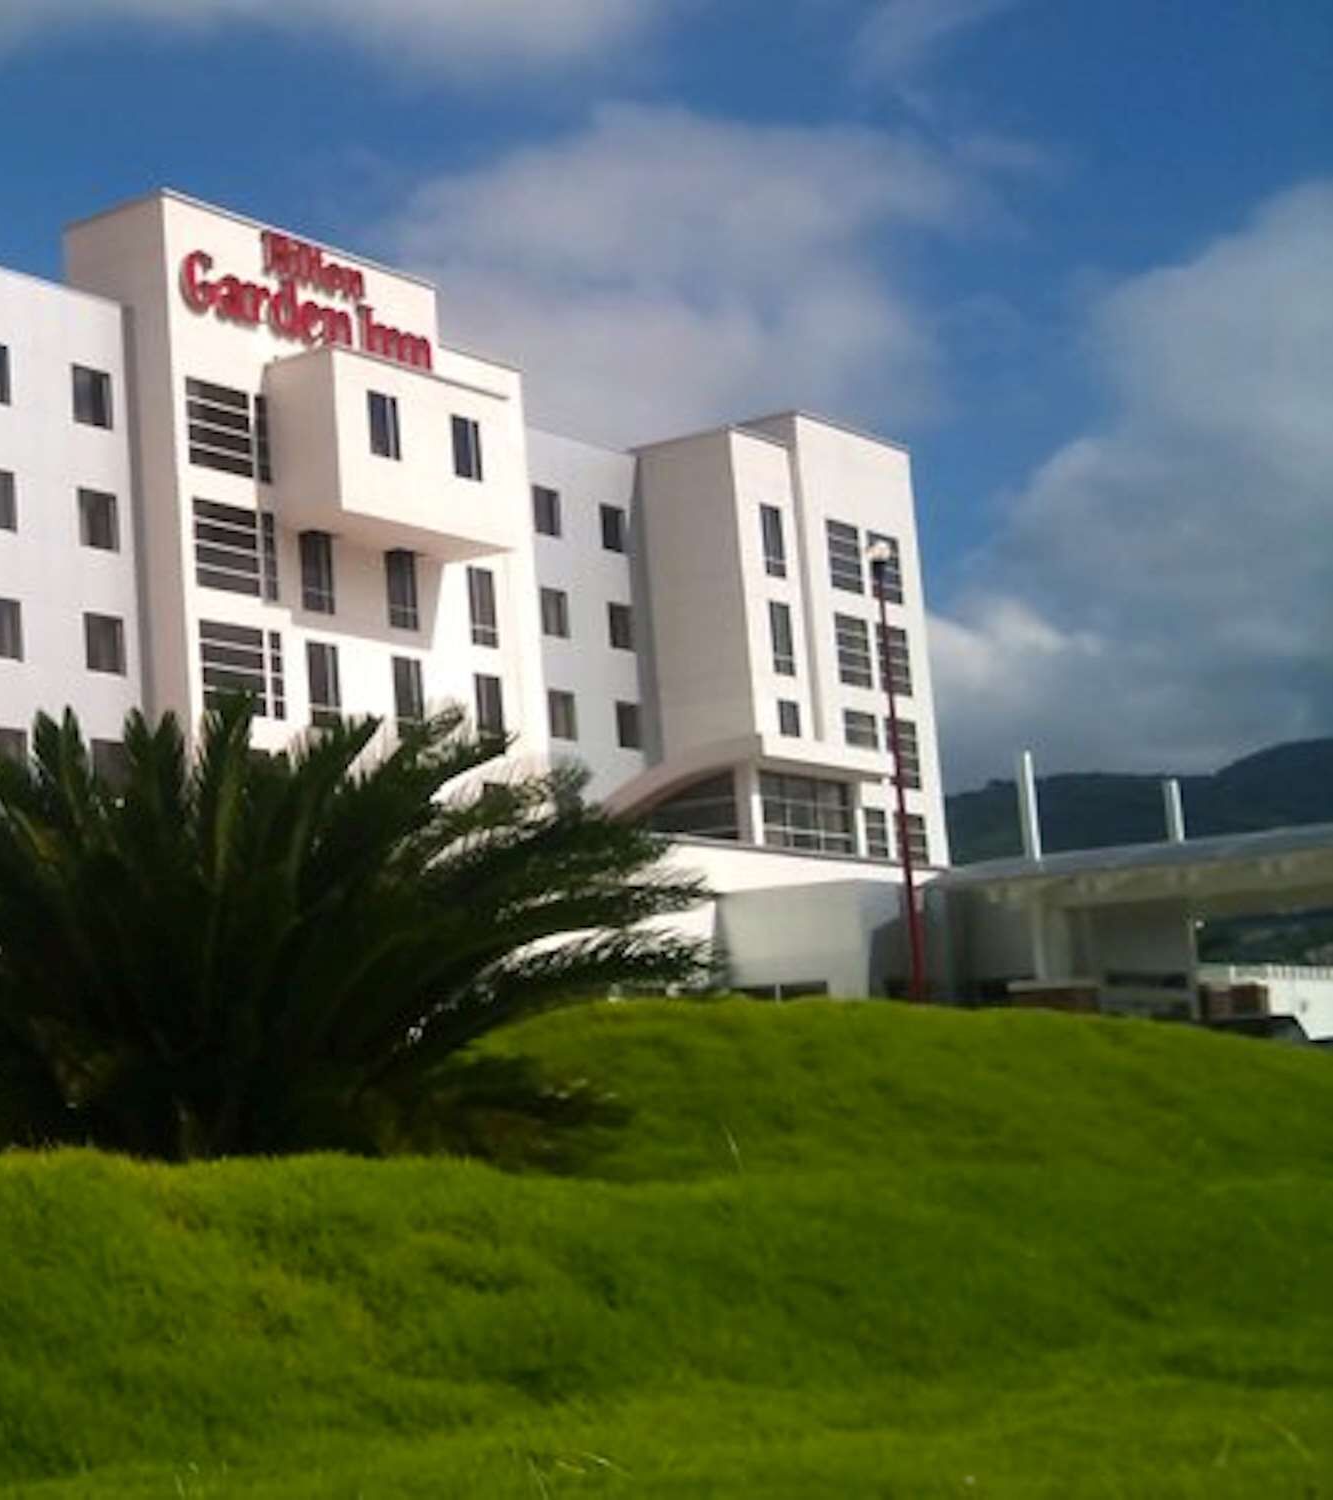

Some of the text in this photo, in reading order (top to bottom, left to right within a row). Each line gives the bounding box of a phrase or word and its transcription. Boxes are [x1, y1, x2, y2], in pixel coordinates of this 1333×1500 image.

[179, 250, 432, 370] Garden Inn
[261, 231, 364, 298] Hilton
